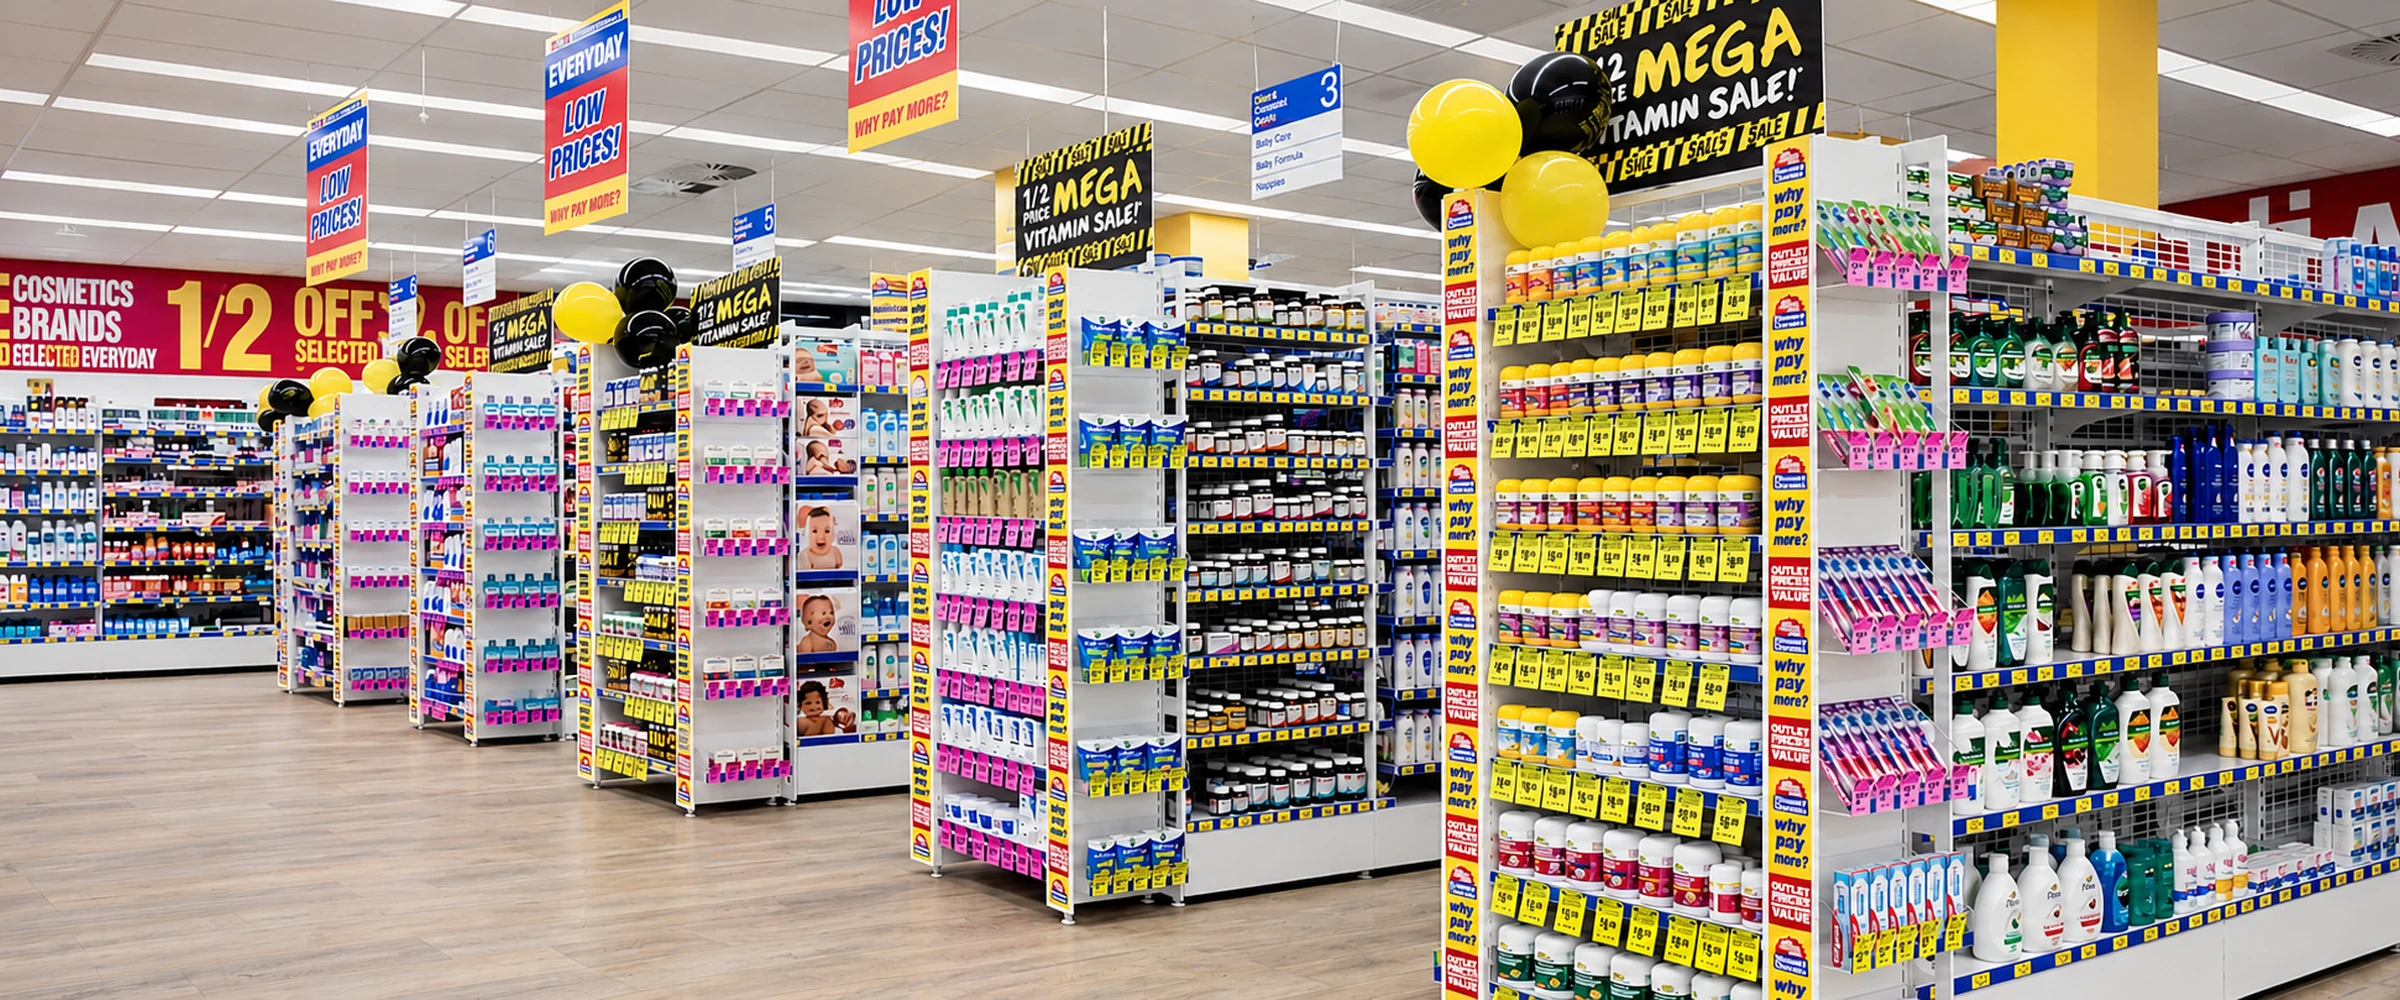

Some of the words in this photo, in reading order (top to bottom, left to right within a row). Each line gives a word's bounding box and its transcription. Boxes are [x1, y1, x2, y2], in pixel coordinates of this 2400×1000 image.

[854, 5, 951, 85] PRICES!
[1632, 7, 1802, 99] MEGA
[549, 31, 624, 89] EVERYDAY
[1320, 71, 1338, 108] 3
[563, 86, 607, 137] LOW
[855, 114, 880, 138] WHY
[882, 105, 905, 129] PAY
[906, 90, 949, 121] MORE?
[1600, 94, 1699, 144] ITAMIN
[1274, 132, 1292, 143] Care
[1747, 114, 1783, 144] SALE
[309, 117, 364, 163] EVERYDAY
[549, 122, 622, 182] PRICES!
[1274, 151, 1303, 166] Formula
[319, 163, 352, 205] LOW
[1053, 158, 1143, 217] MEGA
[1255, 178, 1286, 191] Nappies
[1022, 183, 1050, 211] 1/2
[1774, 187, 1804, 205] why
[550, 204, 569, 224] WHY
[571, 199, 588, 218] PAY
[589, 189, 621, 211] MORE?
[310, 195, 362, 243] PRICES!
[764, 207, 774, 231] 5
[1772, 219, 1806, 236] more?
[487, 232, 494, 254] 6
[1023, 215, 1090, 251] VITAMIN
[409, 276, 416, 295] 6
[1771, 268, 1807, 283] VALUE
[13, 274, 134, 308] COSMETICS
[294, 287, 374, 339] OFF
[716, 282, 772, 324] MEGA
[13, 306, 122, 344] BRANDS
[167, 280, 272, 372] 1/2
[444, 301, 486, 344] OF
[507, 309, 547, 341] MEGA
[295, 339, 378, 364] SELECTED
[1774, 336, 1804, 351] why
[82, 347, 157, 369] EVERYDAY
[1773, 370, 1807, 386] more?
[1771, 403, 1808, 415] OUTLET
[1771, 428, 1808, 439] VALUE
[1449, 500, 1473, 514] why
[1775, 498, 1804, 514] why
[1450, 514, 1472, 528] pay
[1773, 532, 1808, 547] more?
[1771, 565, 1809, 576] OUTLET
[1772, 590, 1809, 602] VALUE
[1775, 659, 1805, 676] why
[1775, 677, 1805, 693] pay
[1774, 694, 1808, 708] more?
[1771, 723, 1809, 737] OUTLET
[1771, 748, 1809, 764] VALUE
[1450, 781, 1472, 795] pay
[1775, 818, 1806, 836] why
[1774, 853, 1808, 869] more?
[1450, 901, 1474, 918] why
[1772, 906, 1810, 925] VALUE
[1775, 979, 1806, 999] why
